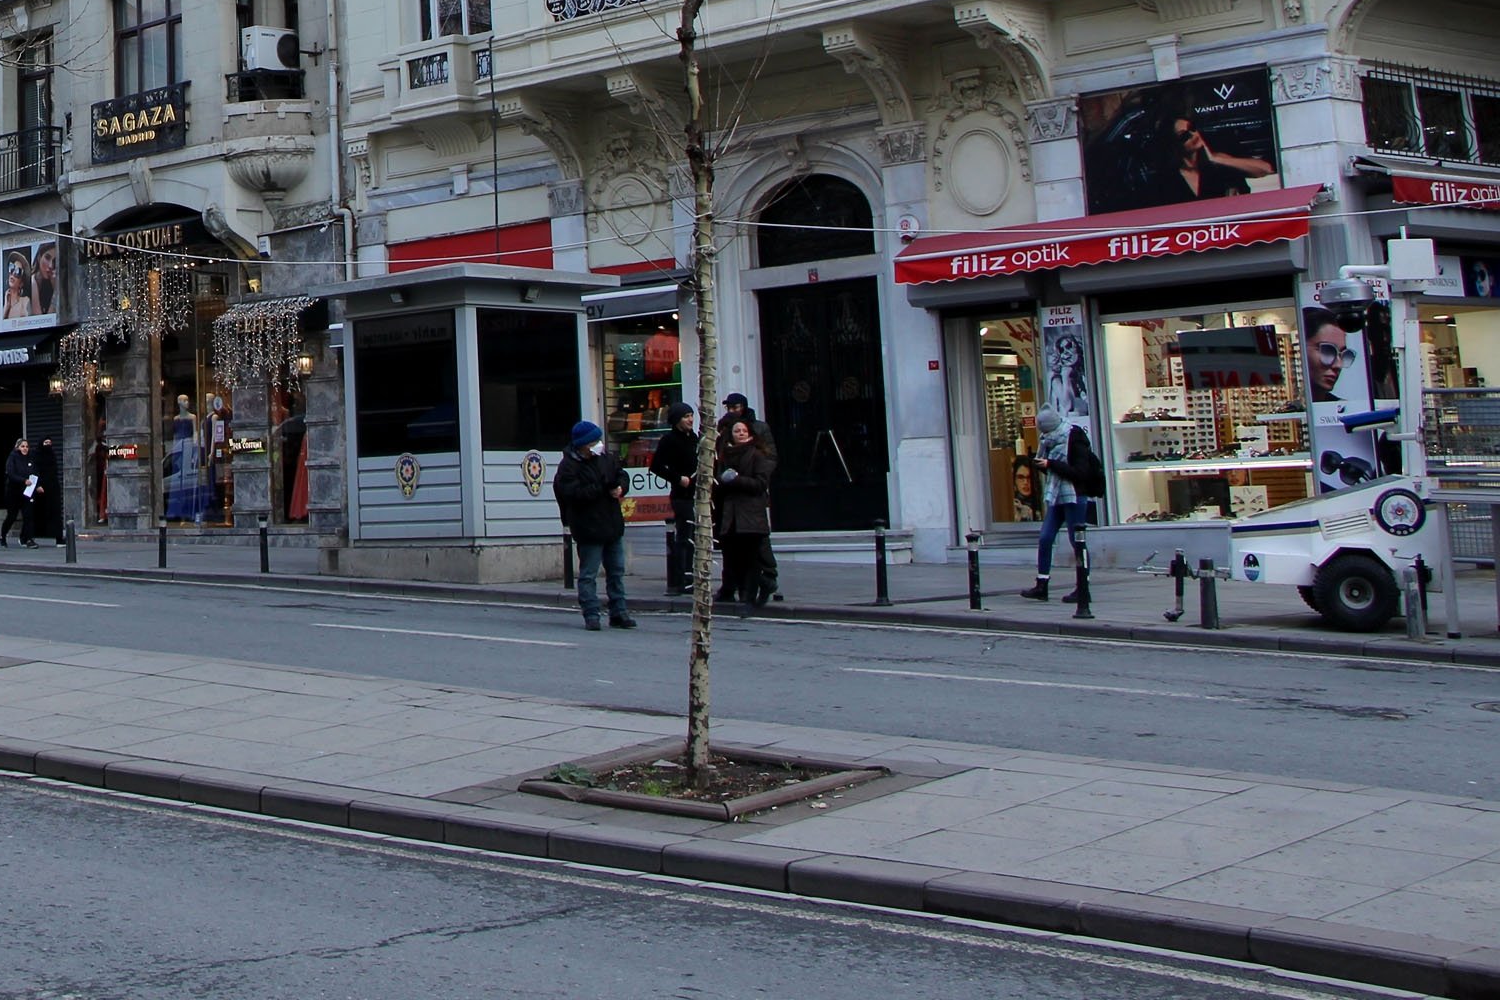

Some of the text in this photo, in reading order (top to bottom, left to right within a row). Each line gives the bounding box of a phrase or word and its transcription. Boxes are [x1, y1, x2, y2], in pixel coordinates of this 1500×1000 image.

[96, 103, 176, 137] SAGAZA
[116, 130, 156, 146] MADRID
[1430, 181, 1468, 203] filiz
[86, 235, 112, 258] FOR
[116, 224, 182, 253] COSTUME
[1107, 223, 1240, 257] filiz optik
[950, 243, 1071, 275] filiz optik
[1048, 315, 1075, 325] OPTİK
[1050, 306, 1071, 315] FİLİZ
